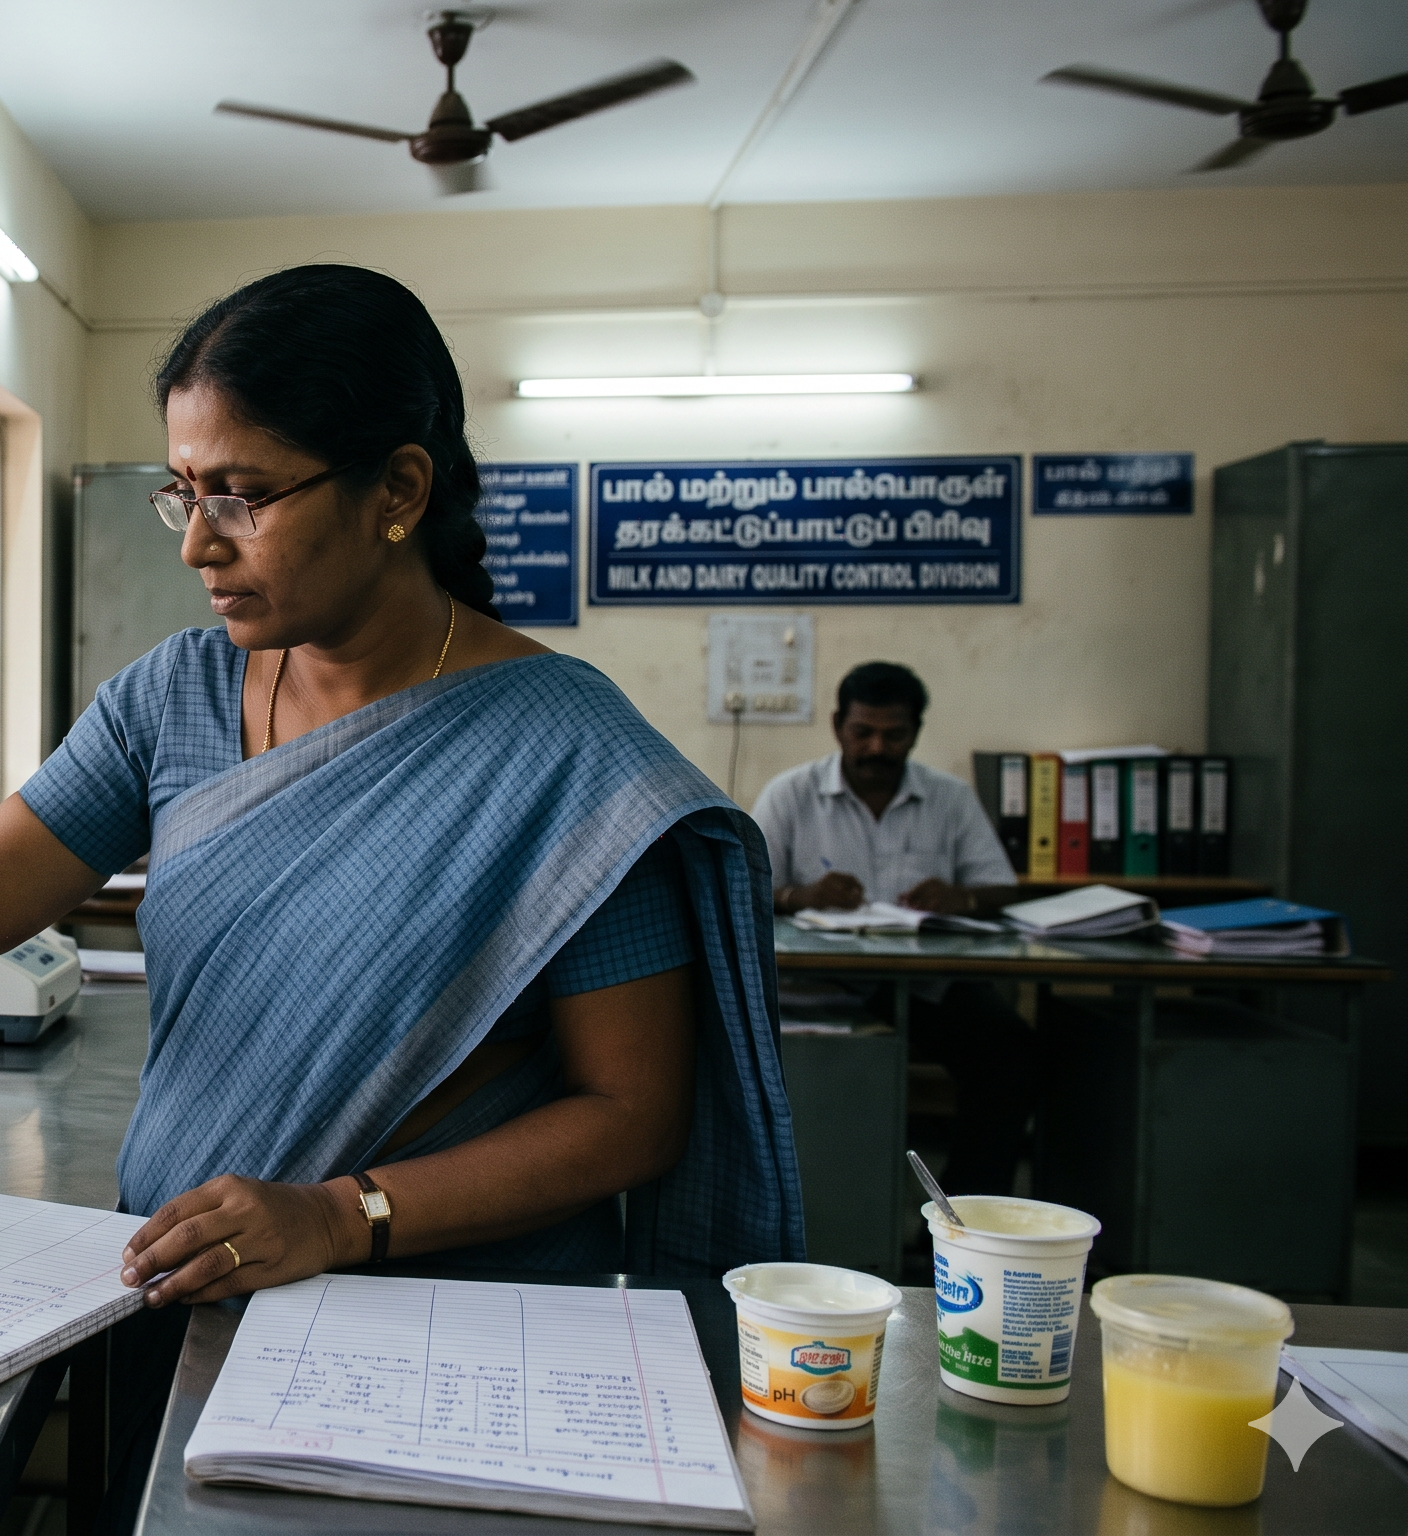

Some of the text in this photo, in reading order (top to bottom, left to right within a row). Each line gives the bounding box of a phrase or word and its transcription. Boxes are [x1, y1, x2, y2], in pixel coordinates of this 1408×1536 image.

[602, 470, 675, 503] பால்
[679, 469, 798, 511] மற்றும்
[614, 510, 898, 549] தரக்கட்டுப்பாட்டுப்
[608, 561, 1001, 591] MILK AND DAIRY QUALITY CONTROL DIVISION
[773, 1387, 796, 1403] pH
